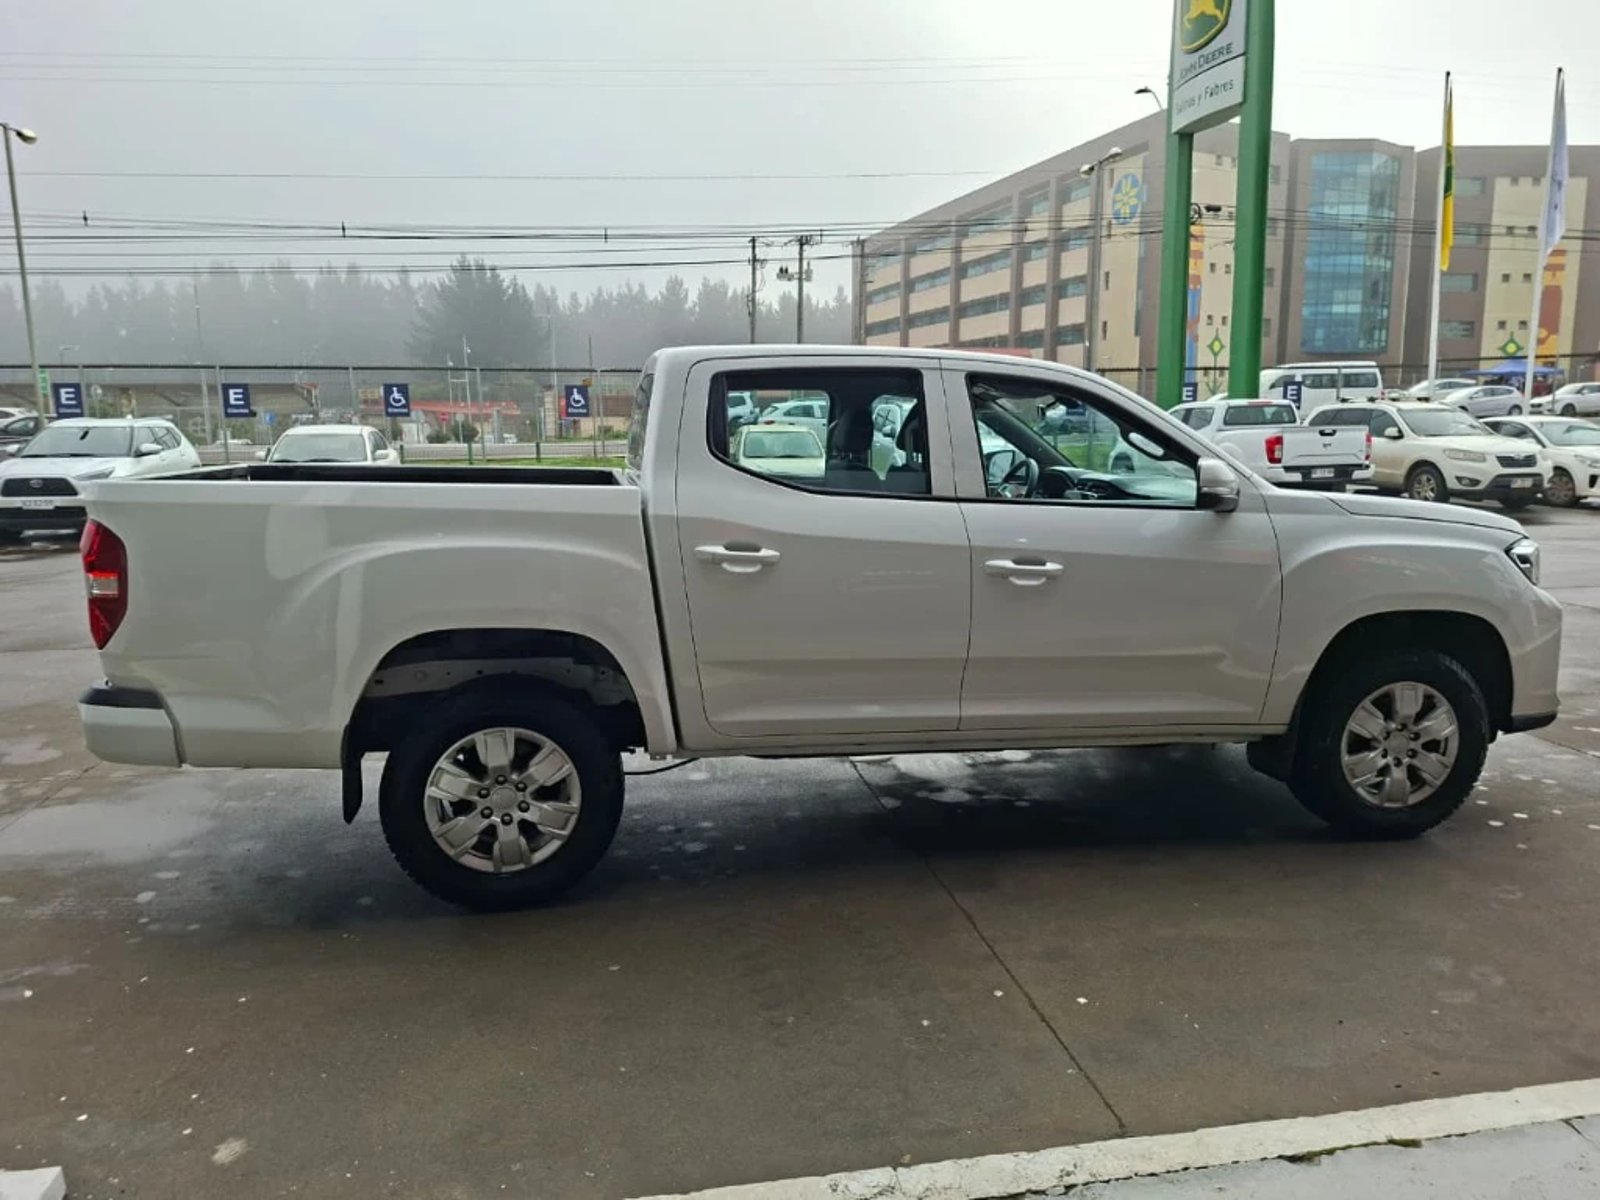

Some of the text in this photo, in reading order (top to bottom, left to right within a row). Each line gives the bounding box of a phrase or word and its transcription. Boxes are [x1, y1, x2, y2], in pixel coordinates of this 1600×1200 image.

[1198, 42, 1233, 67] DEERE
[59, 388, 77, 404] E
[229, 389, 245, 404] E
[1183, 387, 1193, 400] E
[1287, 385, 1298, 399] E
